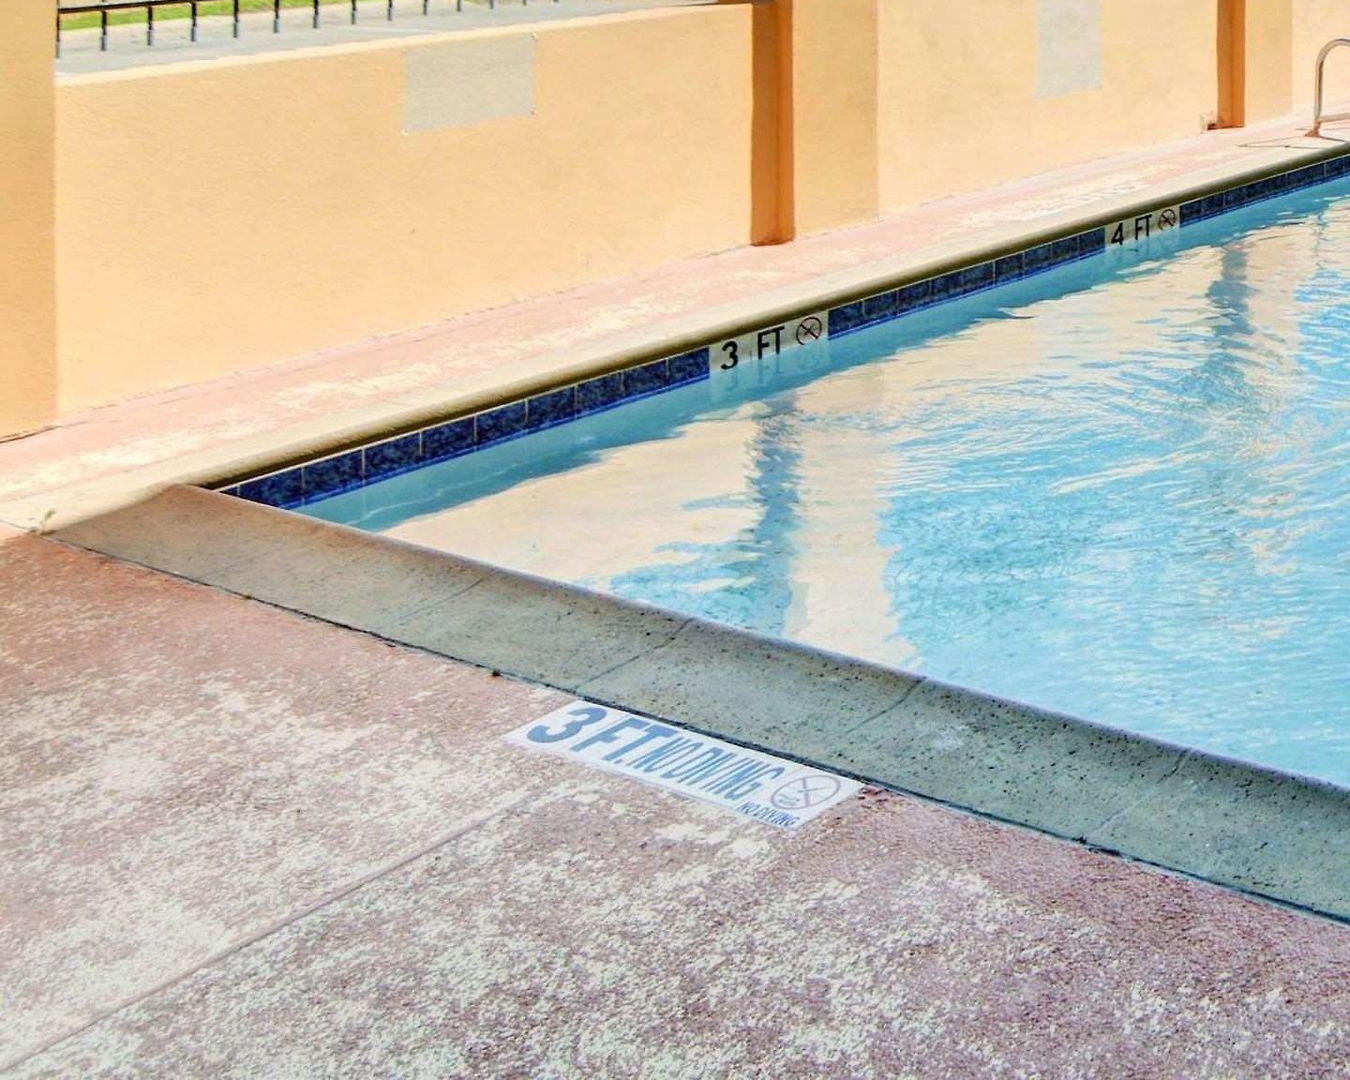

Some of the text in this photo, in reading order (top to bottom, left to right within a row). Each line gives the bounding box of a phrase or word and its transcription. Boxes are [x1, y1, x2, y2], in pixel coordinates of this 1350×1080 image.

[1111, 213, 1152, 245] 4 FT
[721, 325, 785, 370] 3 FT
[526, 707, 607, 744] 3
[659, 746, 785, 801] DIVING
